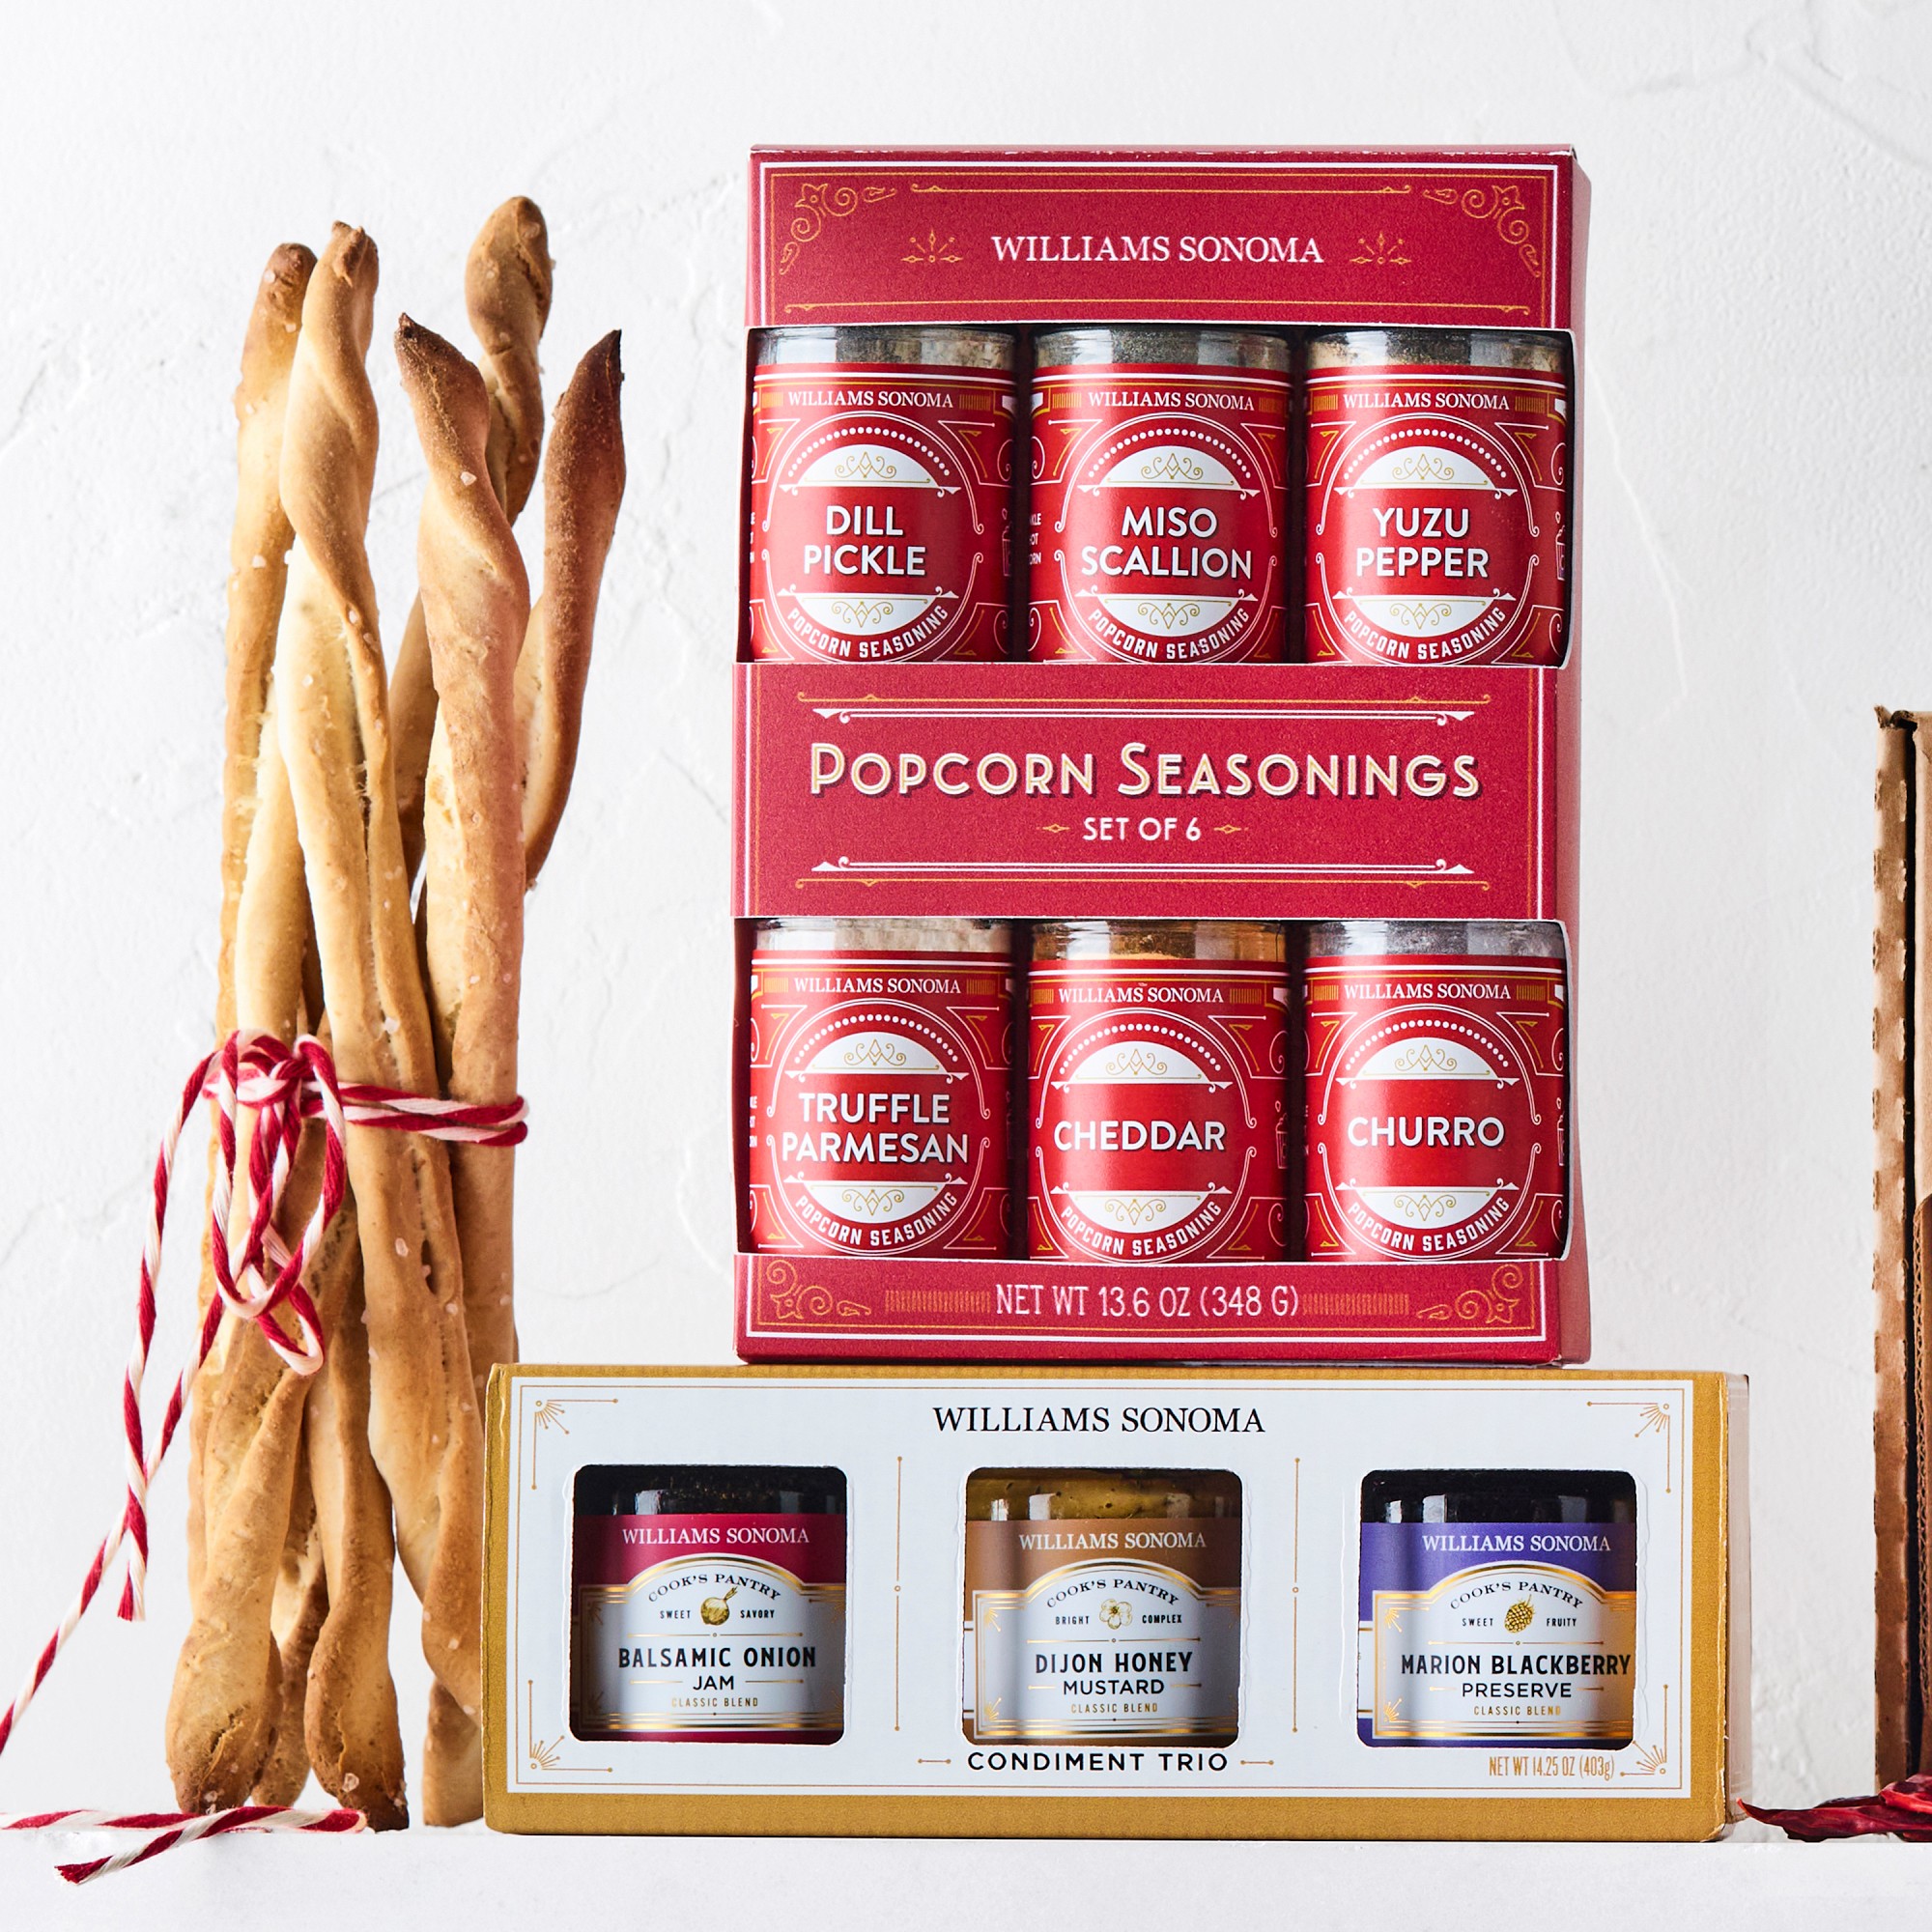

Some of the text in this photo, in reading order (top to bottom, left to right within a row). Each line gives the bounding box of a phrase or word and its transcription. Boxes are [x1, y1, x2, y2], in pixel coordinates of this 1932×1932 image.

[991, 236, 1324, 263] WILLIAMS SONOMA
[788, 391, 953, 409] WILLIAMS SONOMA
[1089, 391, 1254, 412] WILLIAMS SONOMA
[1344, 392, 1510, 411] WILLIAMS SONOMA
[826, 505, 904, 536] DILL
[1122, 506, 1217, 538] MISO
[1372, 507, 1469, 538] YUZU
[803, 545, 926, 577] PICKLE
[1081, 546, 1252, 580] SCALLION
[1356, 547, 1490, 579] PEPPER
[787, 605, 948, 658] POPCORN SEASONING
[1088, 608, 1249, 660] POPCORN SEASONING
[1344, 607, 1506, 660] POPCORN SEASONING
[810, 742, 1481, 799] POPCORN SEASONINGS
[1082, 817, 1202, 841] SET OF 6
[794, 978, 961, 994] WILLIAMS SONOMA
[1059, 986, 1224, 1003] WILLIAMS SONOMA
[1345, 983, 1511, 1000] WILLIAMS SONOMA
[799, 1093, 950, 1123] TRUFFLE
[1054, 1121, 1226, 1151] CHEDDAR
[1348, 1117, 1505, 1147] CHURRO
[781, 1133, 968, 1164] PARMESAN
[795, 1191, 957, 1246] POPCORN SEASONING
[1061, 1201, 1222, 1256] POPCORN SEASONING
[1349, 1197, 1510, 1252] POPCORN SEASONING
[996, 1284, 1299, 1317] NET WT 13.6 OZ (348 G)
[933, 1407, 1265, 1433] WILLIAMS SONOMA
[622, 1527, 810, 1545] WILLIAMS SONOMA
[1019, 1532, 1207, 1549] WILLIAMS SONOMA
[1422, 1535, 1611, 1551] WILLIAMS SONOMA
[648, 1574, 781, 1603] COOK'S PANTRY
[1047, 1578, 1179, 1607] COOK'S PANTRY
[1450, 1581, 1583, 1609] COOK'S PANTRY
[660, 1609, 776, 1619] SWEET SAVORY
[1055, 1614, 1182, 1625] BRIGHT COMPLEX
[1462, 1618, 1577, 1627] SWEET FRUITY
[618, 1646, 816, 1668] BALSAMIC ONION
[1036, 1651, 1193, 1673] DIJON HONEY
[1401, 1655, 1631, 1675] MARION BLACKBERRY
[693, 1675, 734, 1690] JAM
[1064, 1679, 1165, 1694] MUSTARD
[1462, 1683, 1572, 1697] PRESERVE
[671, 1697, 758, 1707] CLASSIC BLEND
[1070, 1703, 1158, 1714] CLASSIC BLEND
[1474, 1706, 1561, 1716] CLASSIC BLEND
[968, 1752, 1228, 1771] CONDIMENT TRIO
[1489, 1754, 1615, 1780] NET WT 14.25 OZ (403g)
